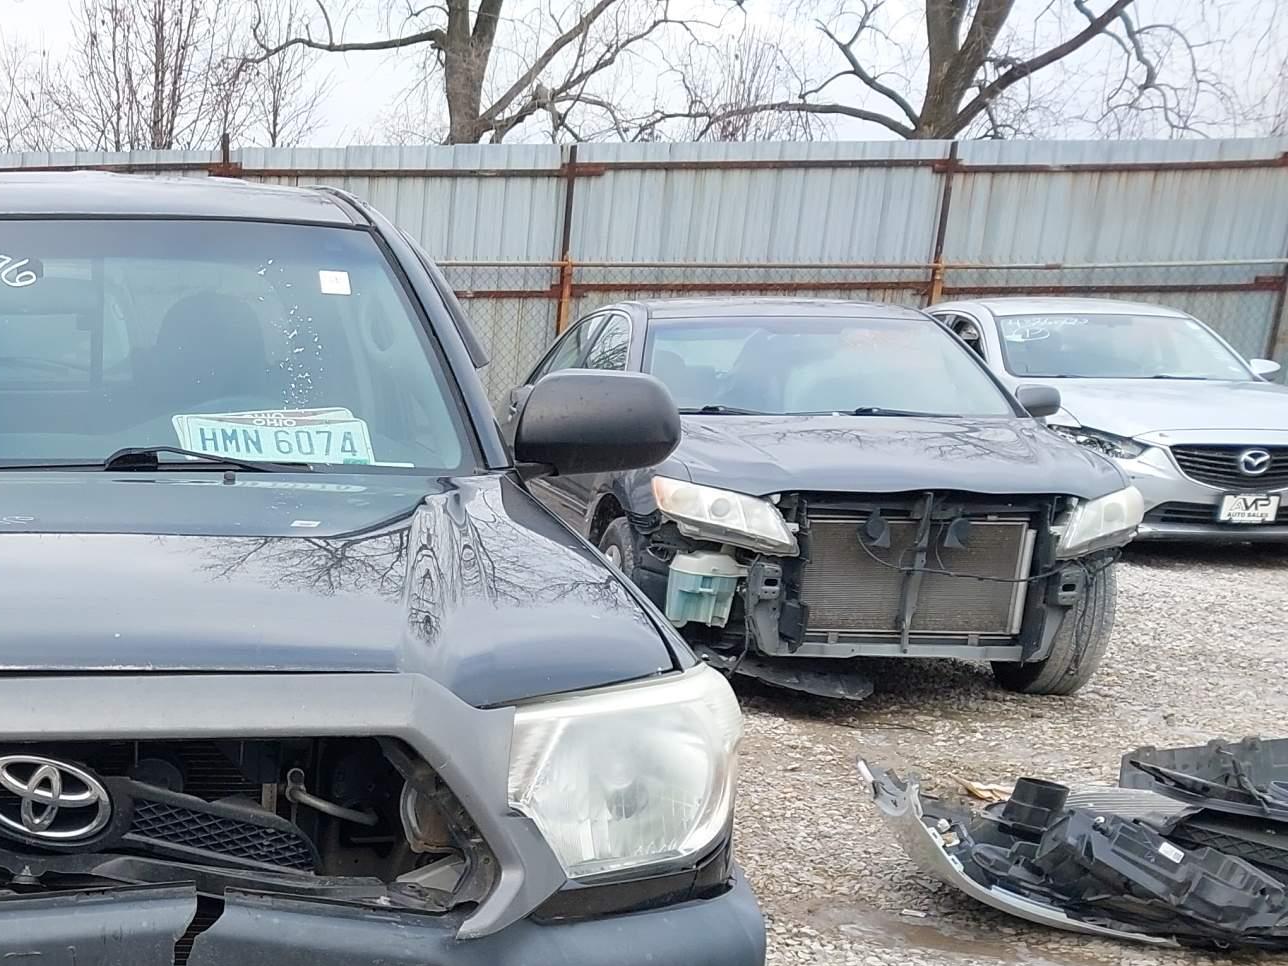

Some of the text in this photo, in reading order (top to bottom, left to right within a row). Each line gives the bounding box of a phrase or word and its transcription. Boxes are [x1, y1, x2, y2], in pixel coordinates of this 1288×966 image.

[253, 418, 297, 427] OHIO
[199, 427, 358, 456] HMN 6074
